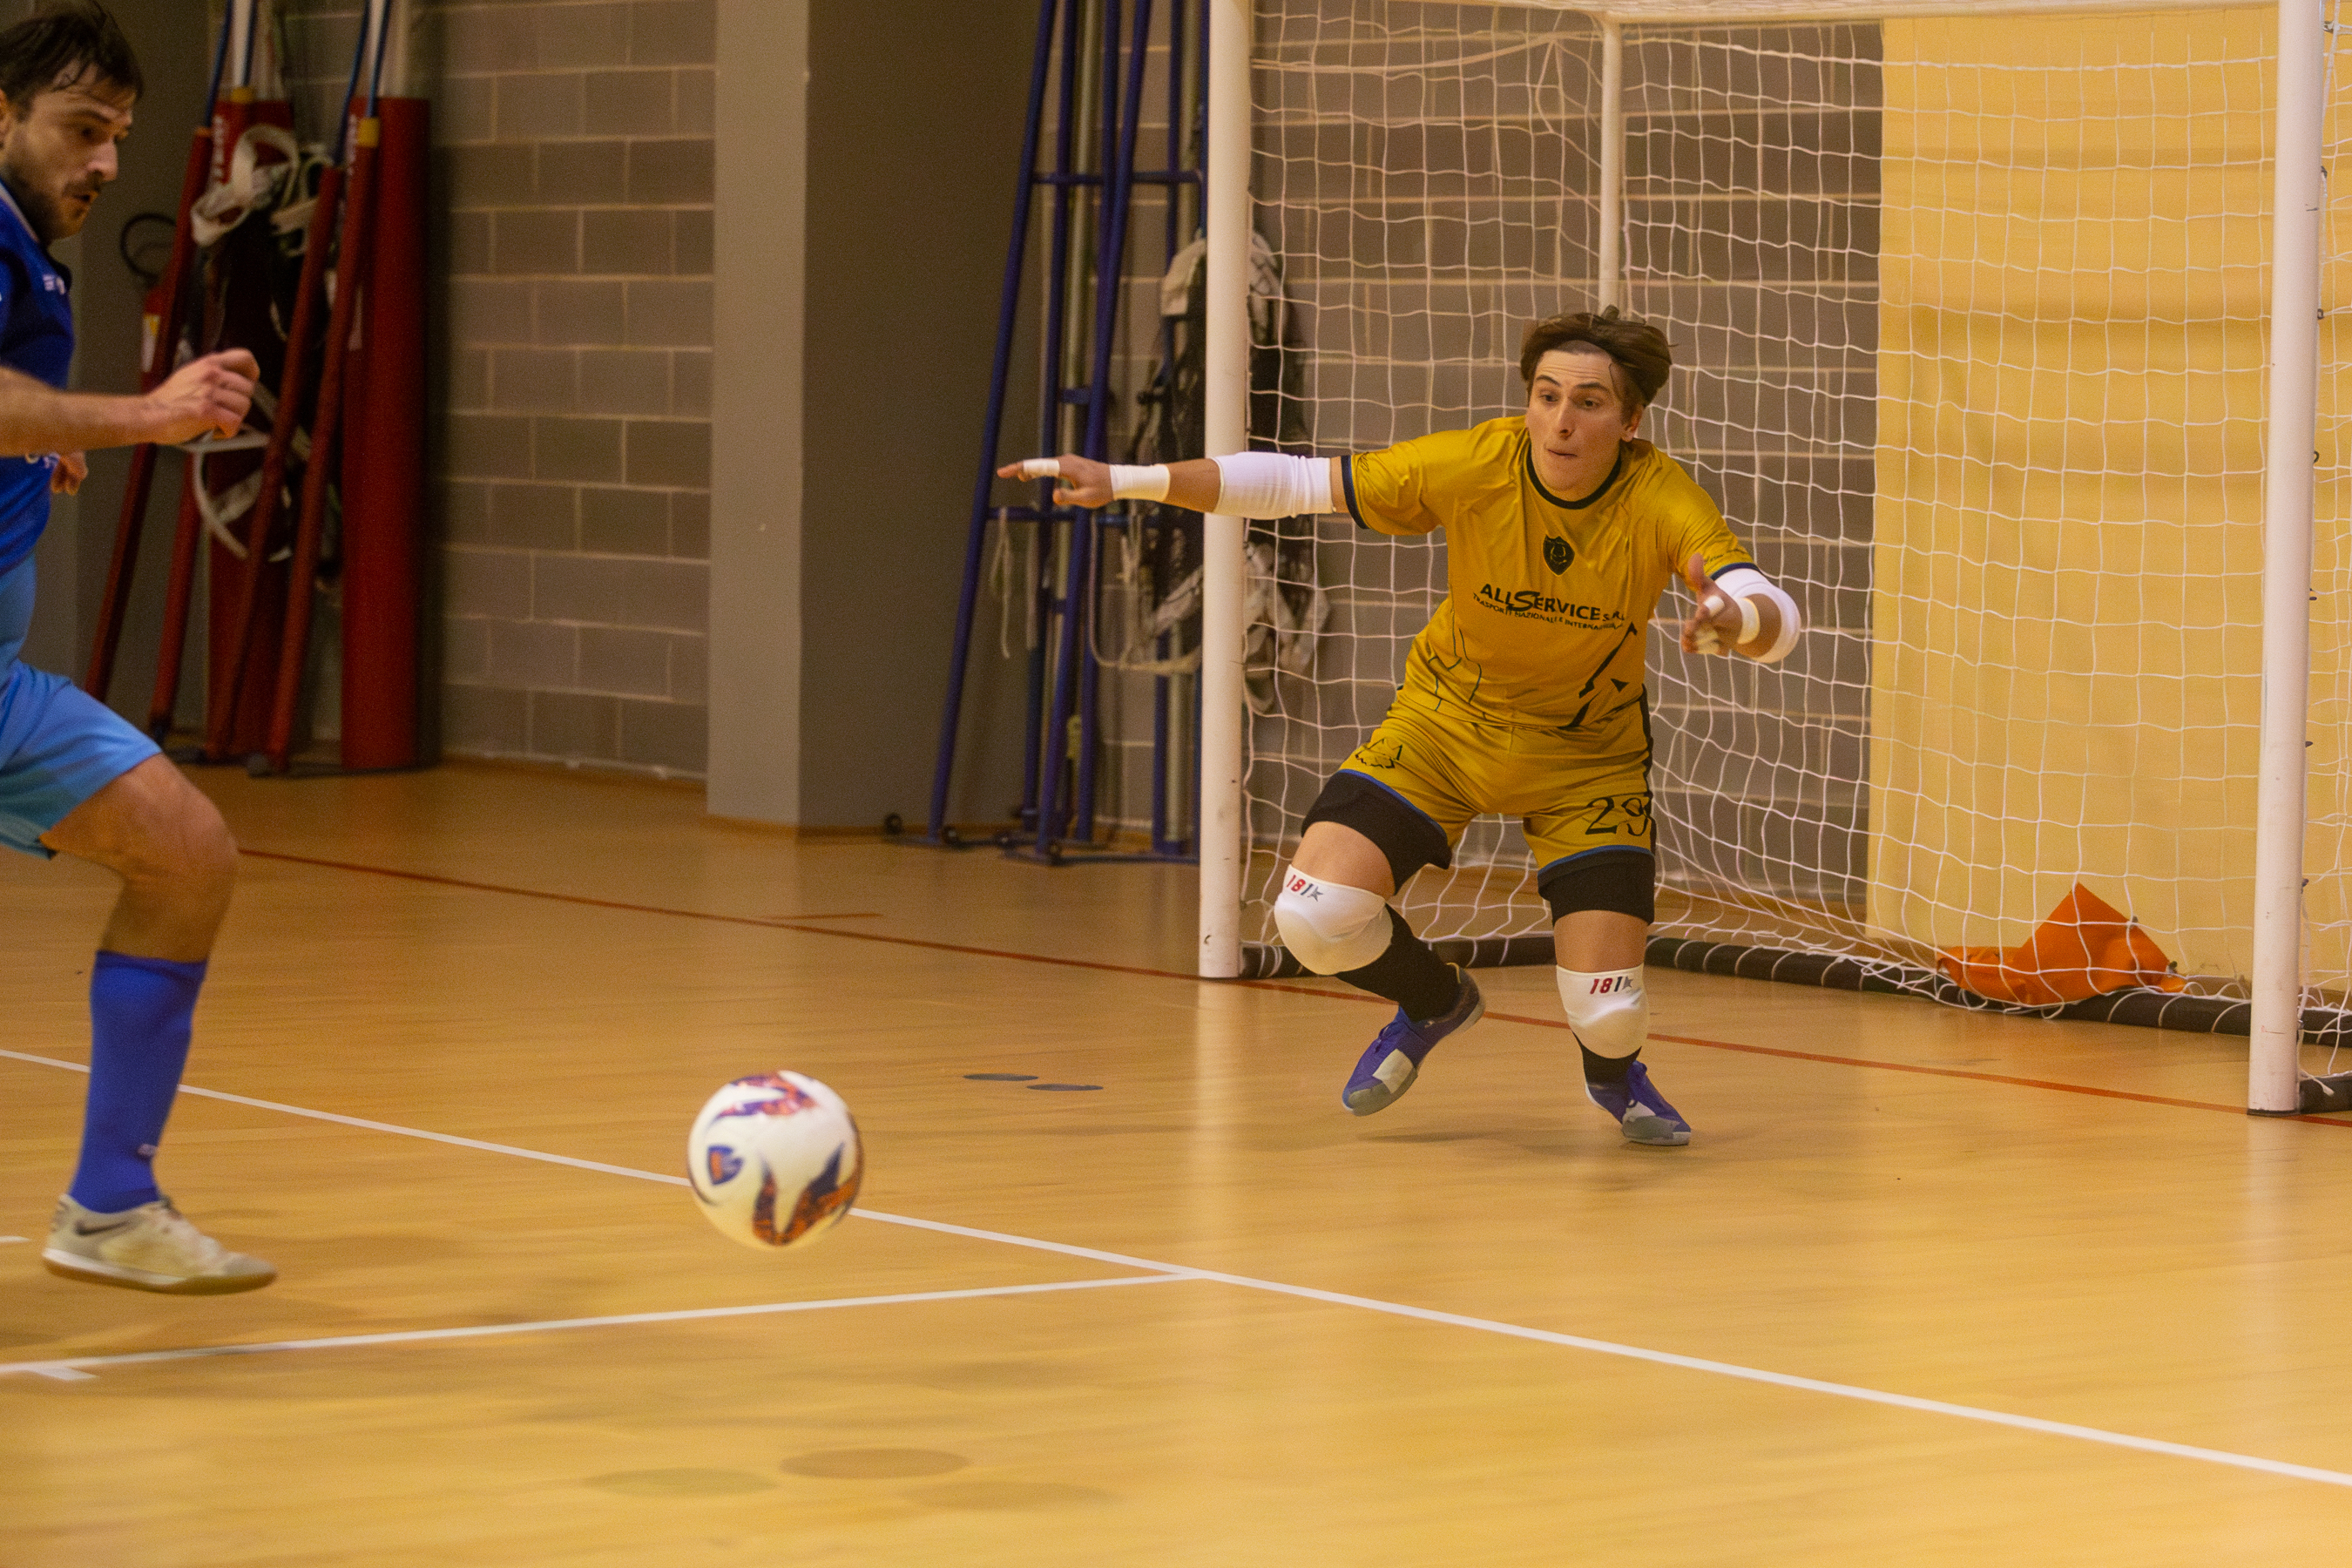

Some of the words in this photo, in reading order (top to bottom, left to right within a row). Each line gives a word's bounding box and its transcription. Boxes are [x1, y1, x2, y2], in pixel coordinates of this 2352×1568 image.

[1585, 796, 1649, 836] 29
[1286, 874, 1314, 896] 181
[1590, 976, 1623, 995] 181
